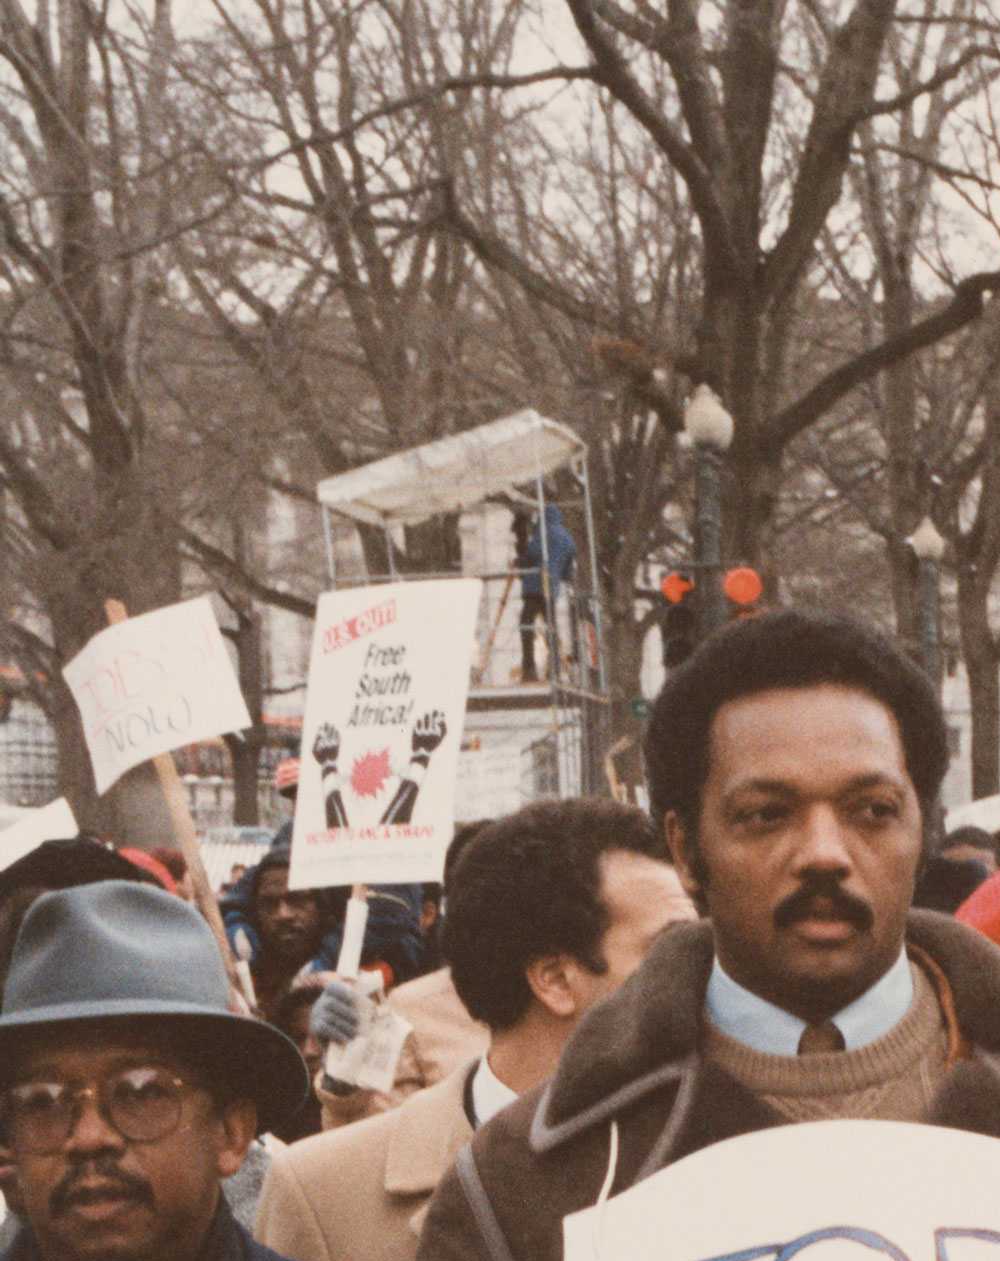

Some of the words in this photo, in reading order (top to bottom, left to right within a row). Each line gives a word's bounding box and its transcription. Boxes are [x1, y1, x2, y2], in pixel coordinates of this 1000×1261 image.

[364, 641, 406, 668] Free
[354, 667, 412, 699] South
[347, 699, 415, 728] Africa!
